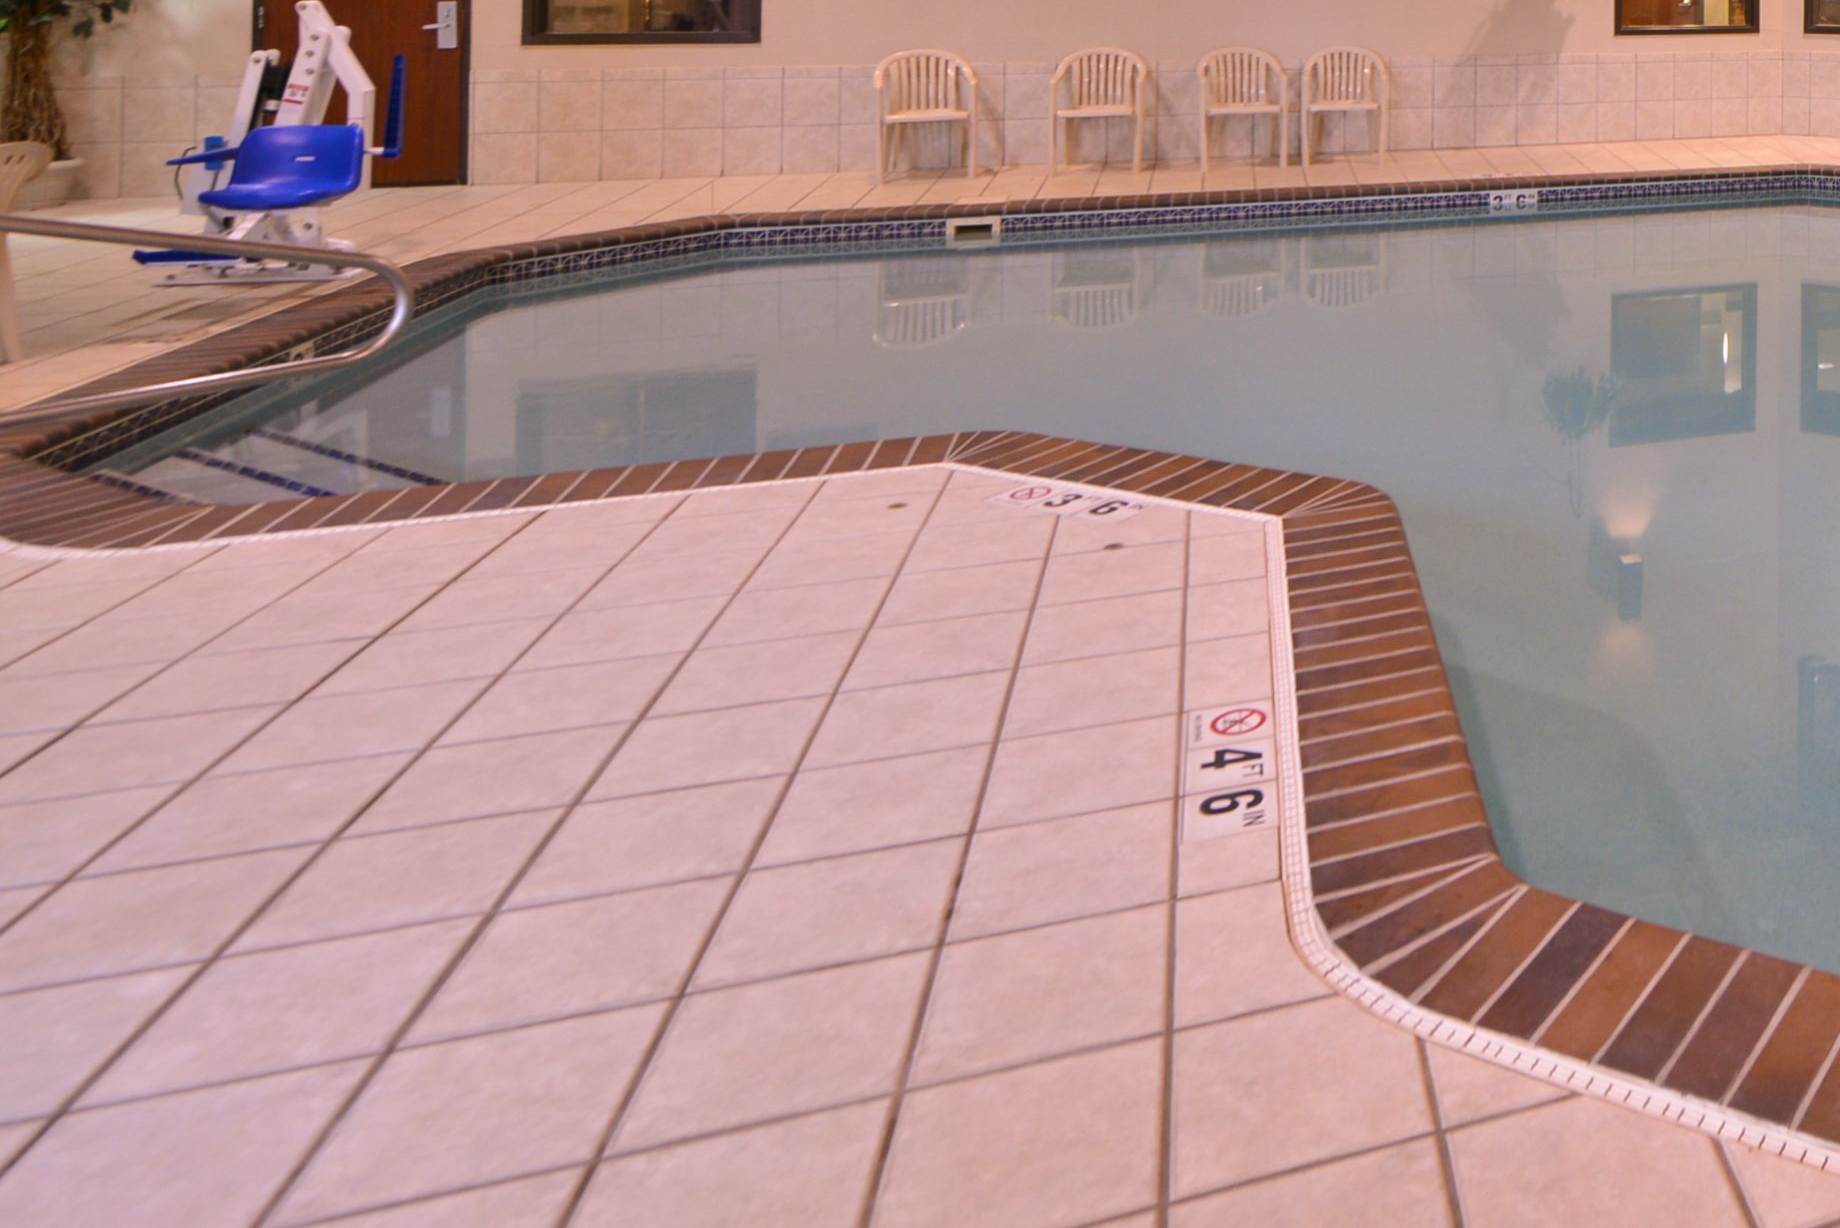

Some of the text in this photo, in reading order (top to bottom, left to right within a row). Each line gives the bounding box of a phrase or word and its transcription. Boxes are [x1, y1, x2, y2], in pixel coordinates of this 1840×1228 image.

[1043, 493, 1083, 507] 3
[1088, 500, 1129, 515] 6
[1199, 748, 1265, 827] 4 FT 6 IN
